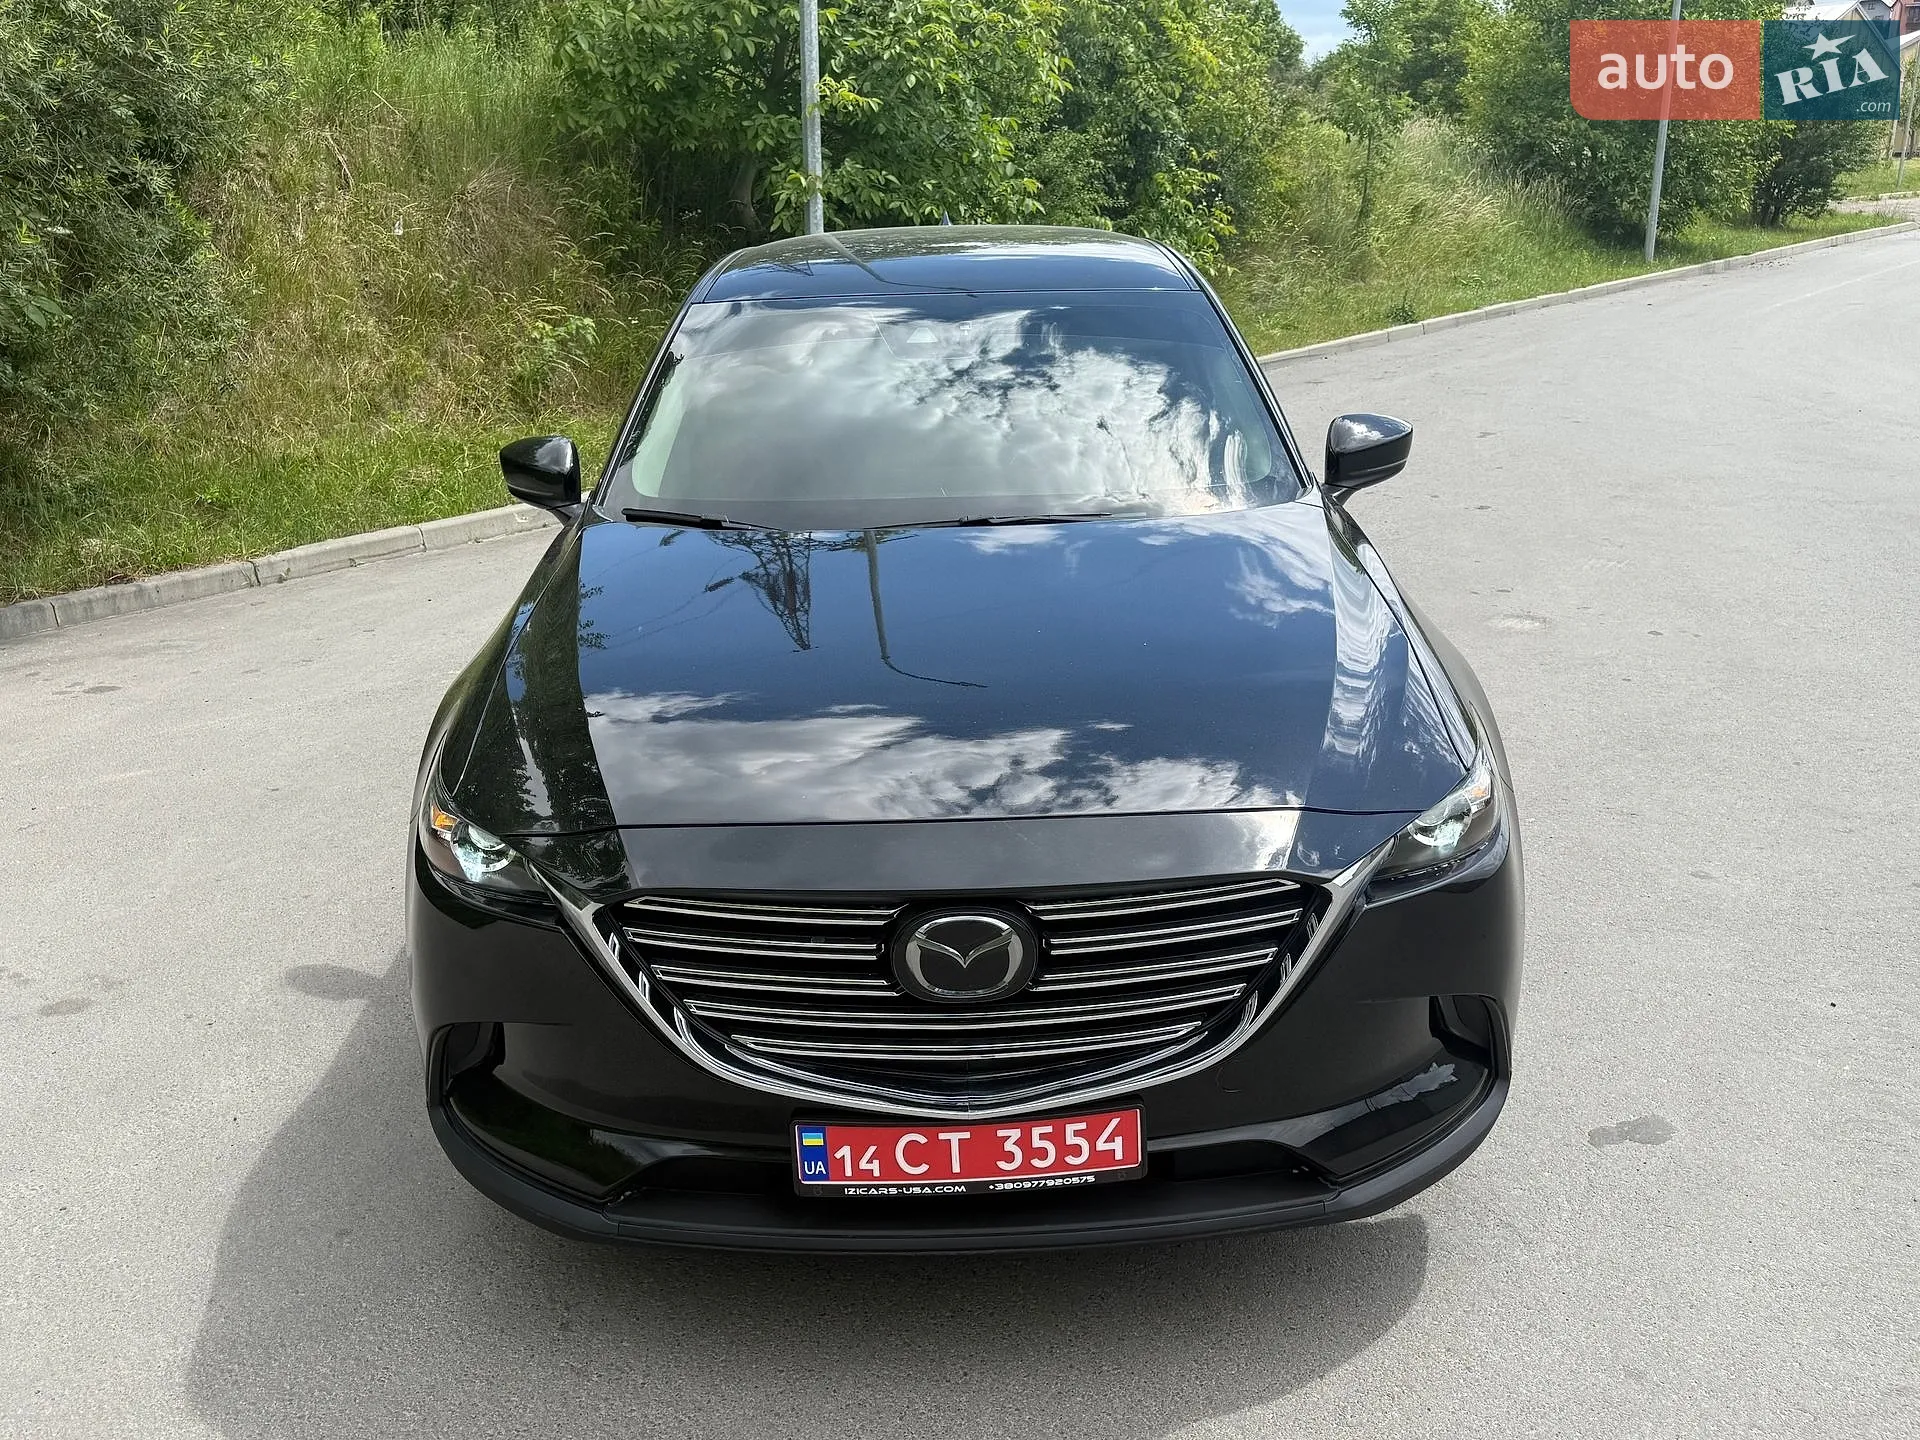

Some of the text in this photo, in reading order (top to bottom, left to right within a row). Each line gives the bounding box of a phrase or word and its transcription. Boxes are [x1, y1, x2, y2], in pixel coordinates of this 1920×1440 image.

[834, 1117, 1124, 1177] 14 CT 3554
[804, 1162, 827, 1175] UA
[844, 1183, 967, 1195] IZICARS-USA.COM
